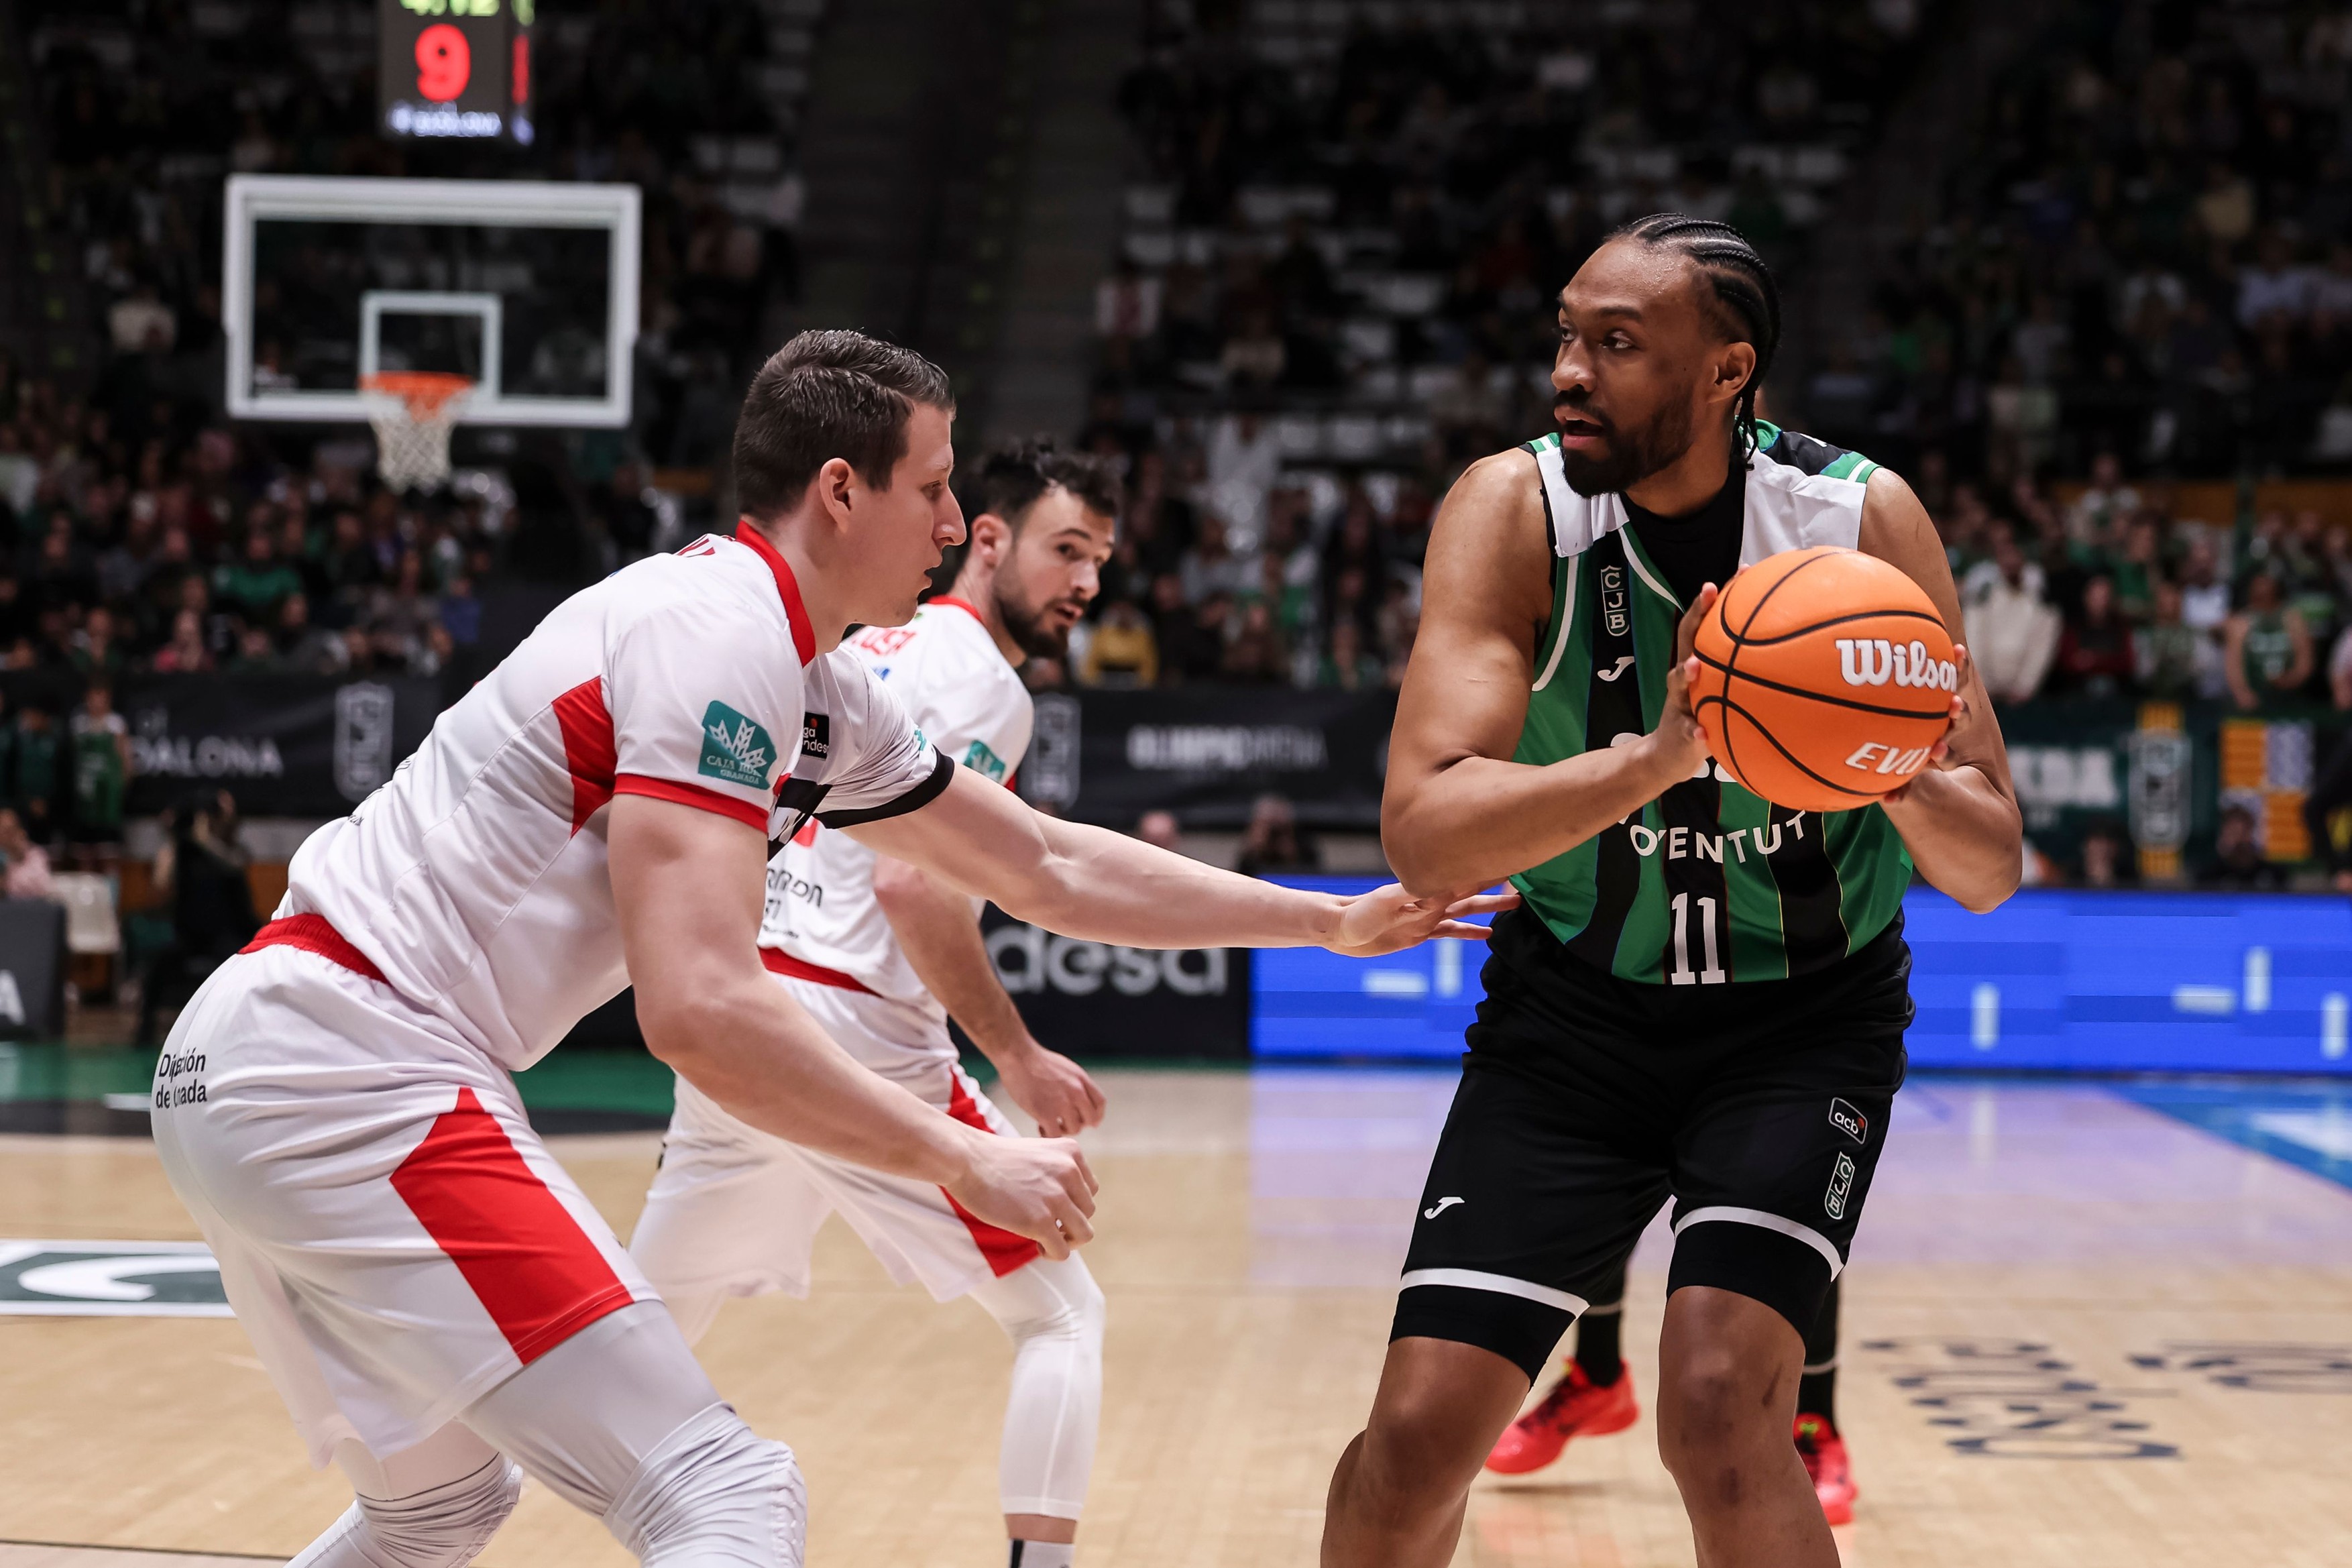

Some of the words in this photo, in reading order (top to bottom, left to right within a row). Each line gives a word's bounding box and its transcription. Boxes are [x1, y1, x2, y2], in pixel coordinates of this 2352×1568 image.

[414, 23, 471, 105] 9
[1835, 638, 1958, 693] Wilson
[803, 727, 816, 738] ga
[803, 739, 829, 753] ndes
[706, 755, 735, 770] CAJA
[1618, 809, 1806, 864] OENTUT
[1671, 892, 1726, 985] 11
[156, 1084, 170, 1109] de
[1834, 1112, 1859, 1135] acb
